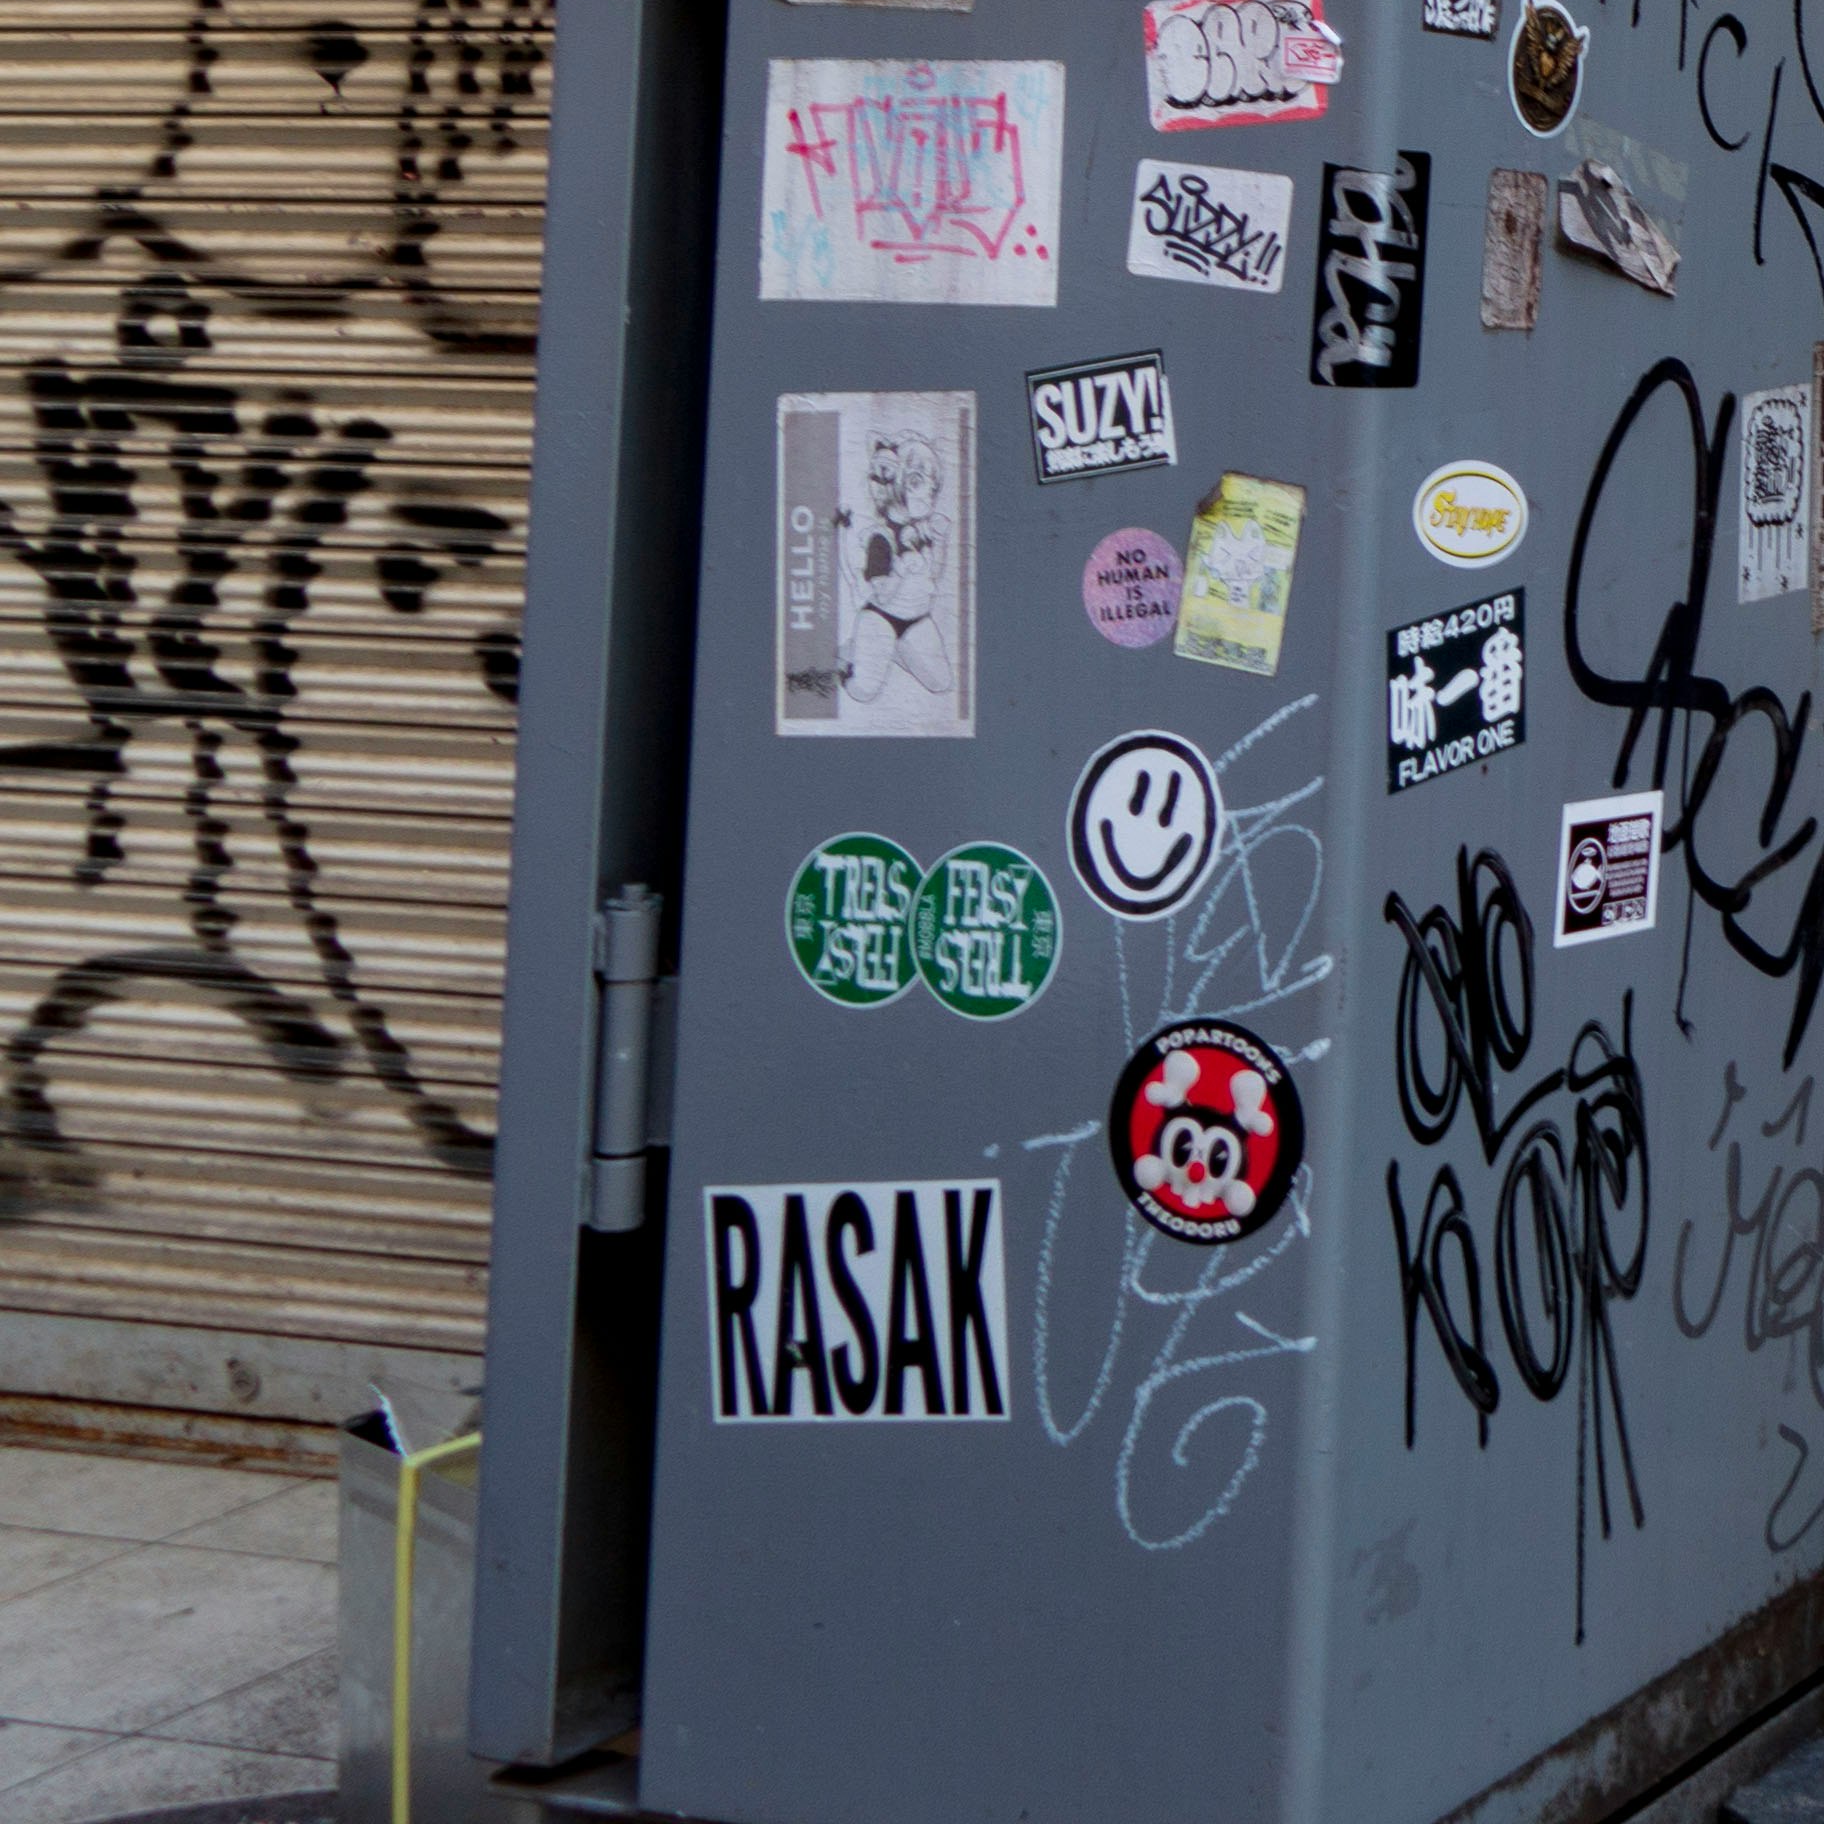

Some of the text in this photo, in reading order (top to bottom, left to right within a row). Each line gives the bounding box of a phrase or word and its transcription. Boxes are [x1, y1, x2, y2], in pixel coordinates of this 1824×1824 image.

[1034, 365, 1164, 450] SUZY!
[790, 504, 815, 631] HELLO
[1097, 565, 1169, 587] HUMAN
[1116, 548, 1147, 566] NO
[1100, 599, 1172, 623] ILLEGAL
[1126, 584, 1143, 601] IS
[1389, 625, 1524, 751] 味一番
[1399, 719, 1516, 788] FLAVOR ONE
[1155, 1027, 1283, 1085] POPARTOONS
[711, 1187, 1006, 1418] RASAK
